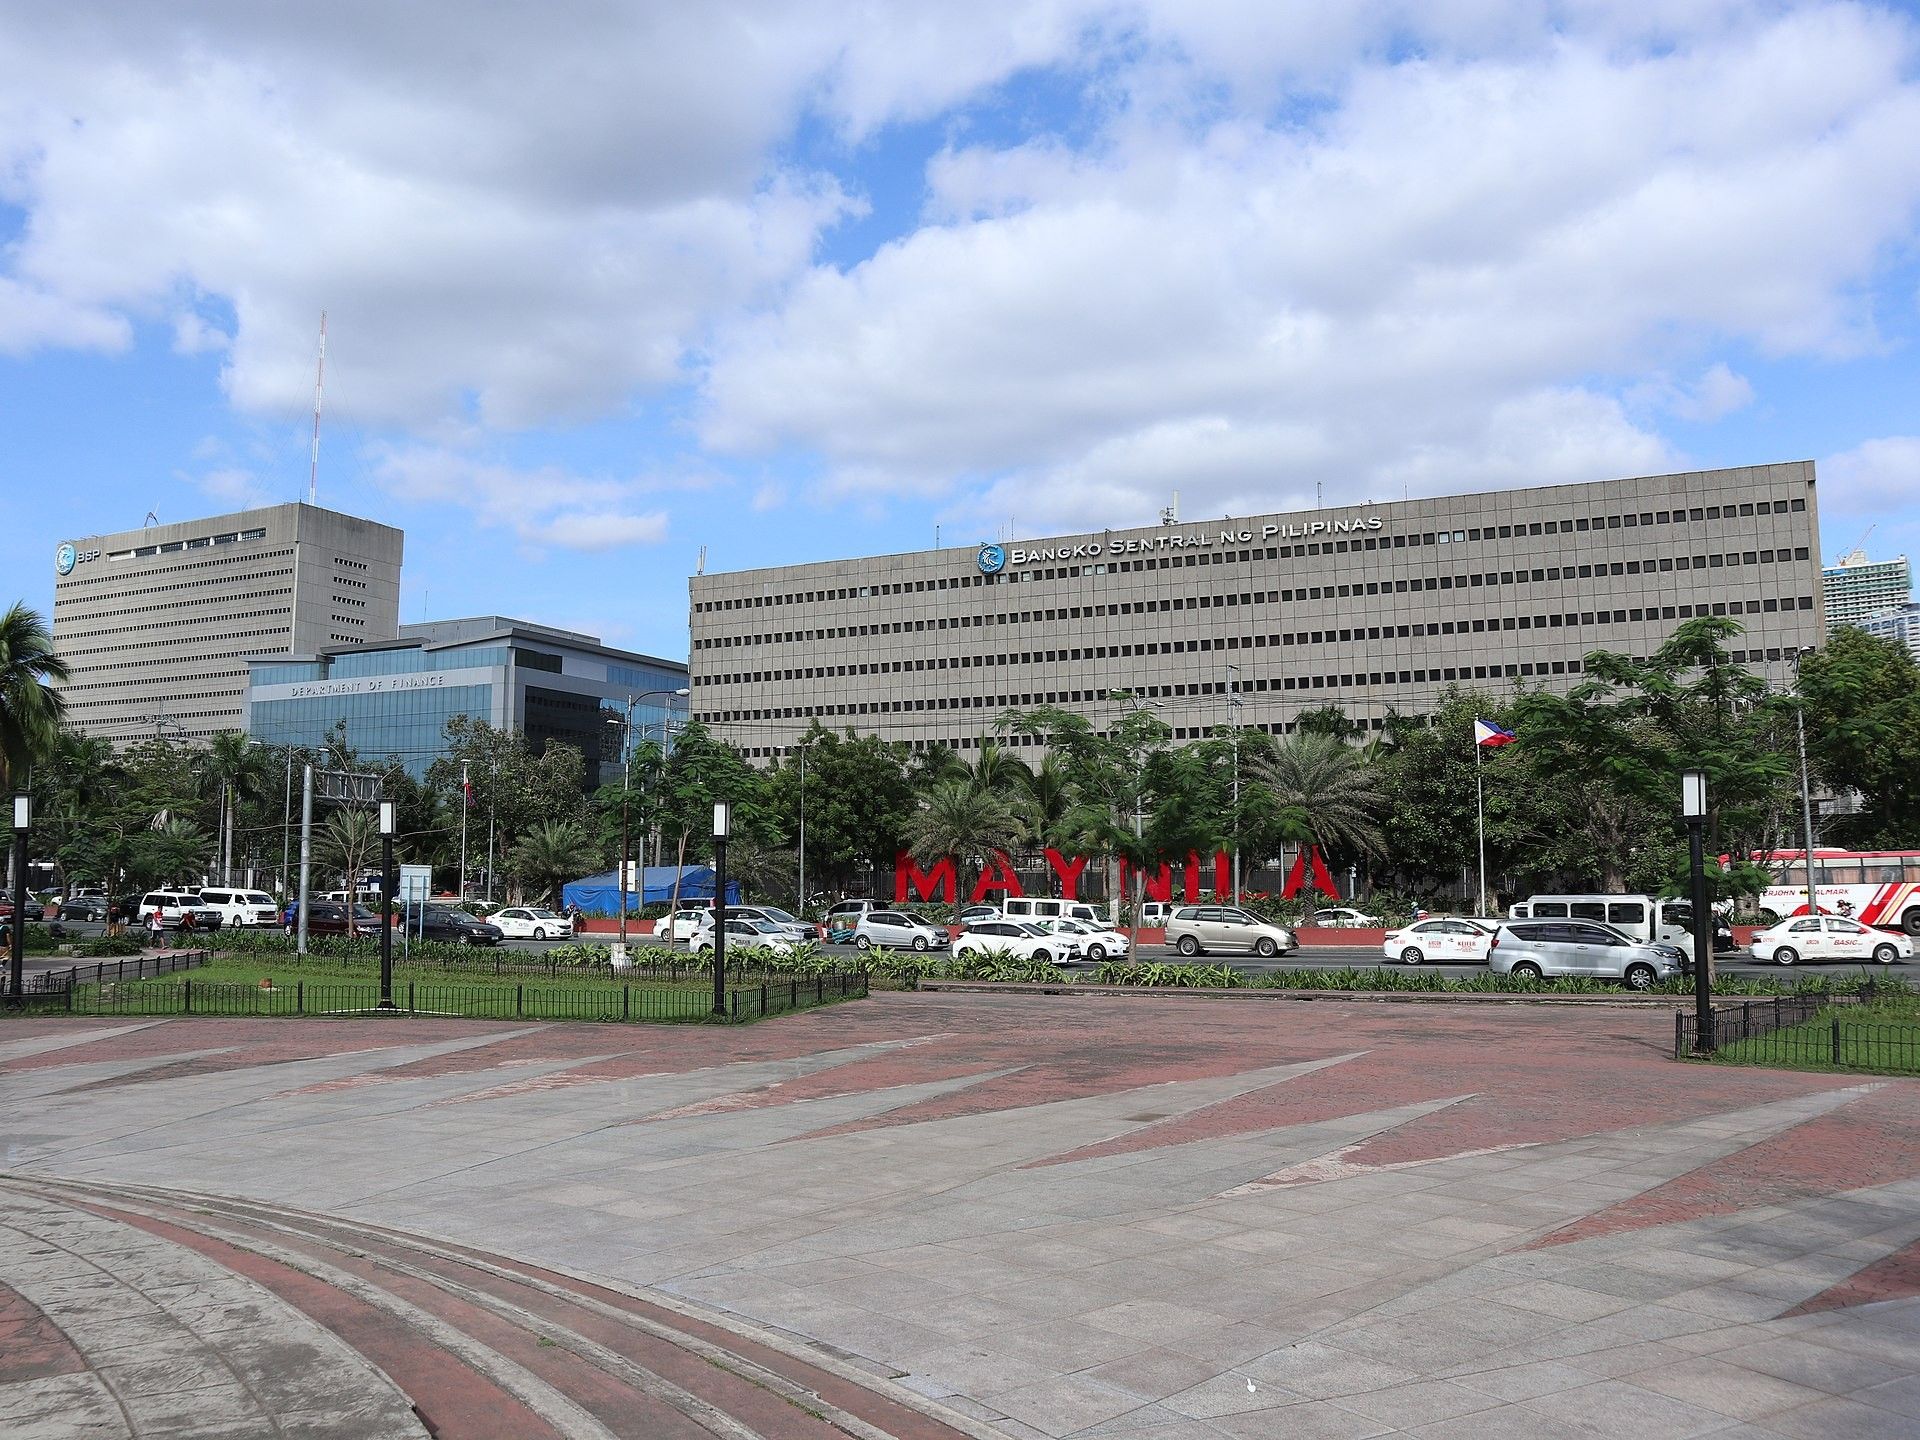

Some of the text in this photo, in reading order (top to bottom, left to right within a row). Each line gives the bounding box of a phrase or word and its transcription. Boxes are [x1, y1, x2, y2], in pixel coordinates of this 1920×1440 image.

[1011, 515, 1384, 564] BANGKO SENTRAL NG PILIPINAS
[78, 549, 101, 563] BSP
[291, 675, 445, 697] DEPARTMENT OF FINANCE
